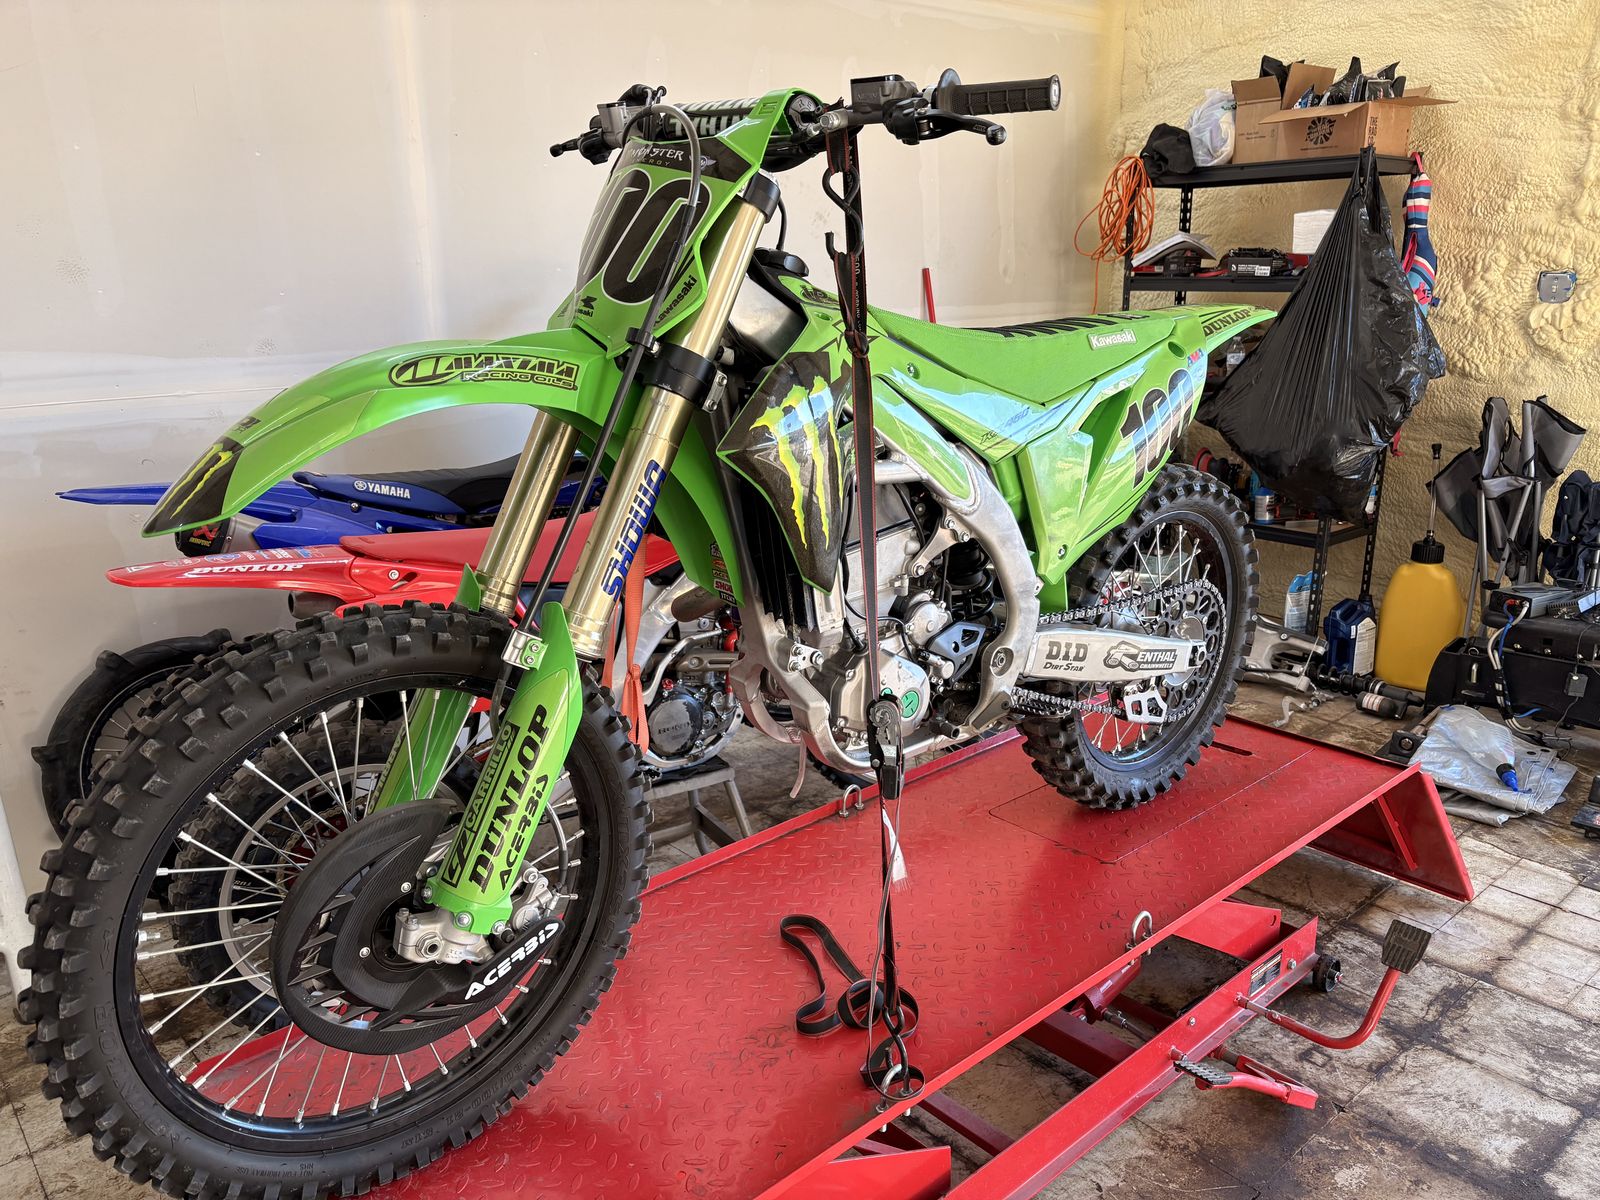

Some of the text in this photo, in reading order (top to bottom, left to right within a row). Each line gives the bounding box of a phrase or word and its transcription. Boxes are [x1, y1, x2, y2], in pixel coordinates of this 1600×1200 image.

[1203, 308, 1252, 337] DUNLOP
[1090, 330, 1136, 348] Kawasaki
[533, 376, 574, 390] OILS
[367, 481, 411, 499] YAMAHA
[185, 563, 305, 578] DUNLOP
[465, 724, 513, 829] CARRILLO
[469, 704, 550, 895] DUNLOP
[499, 773, 549, 891] ACERBIS
[464, 922, 560, 1001] ACERBIS
